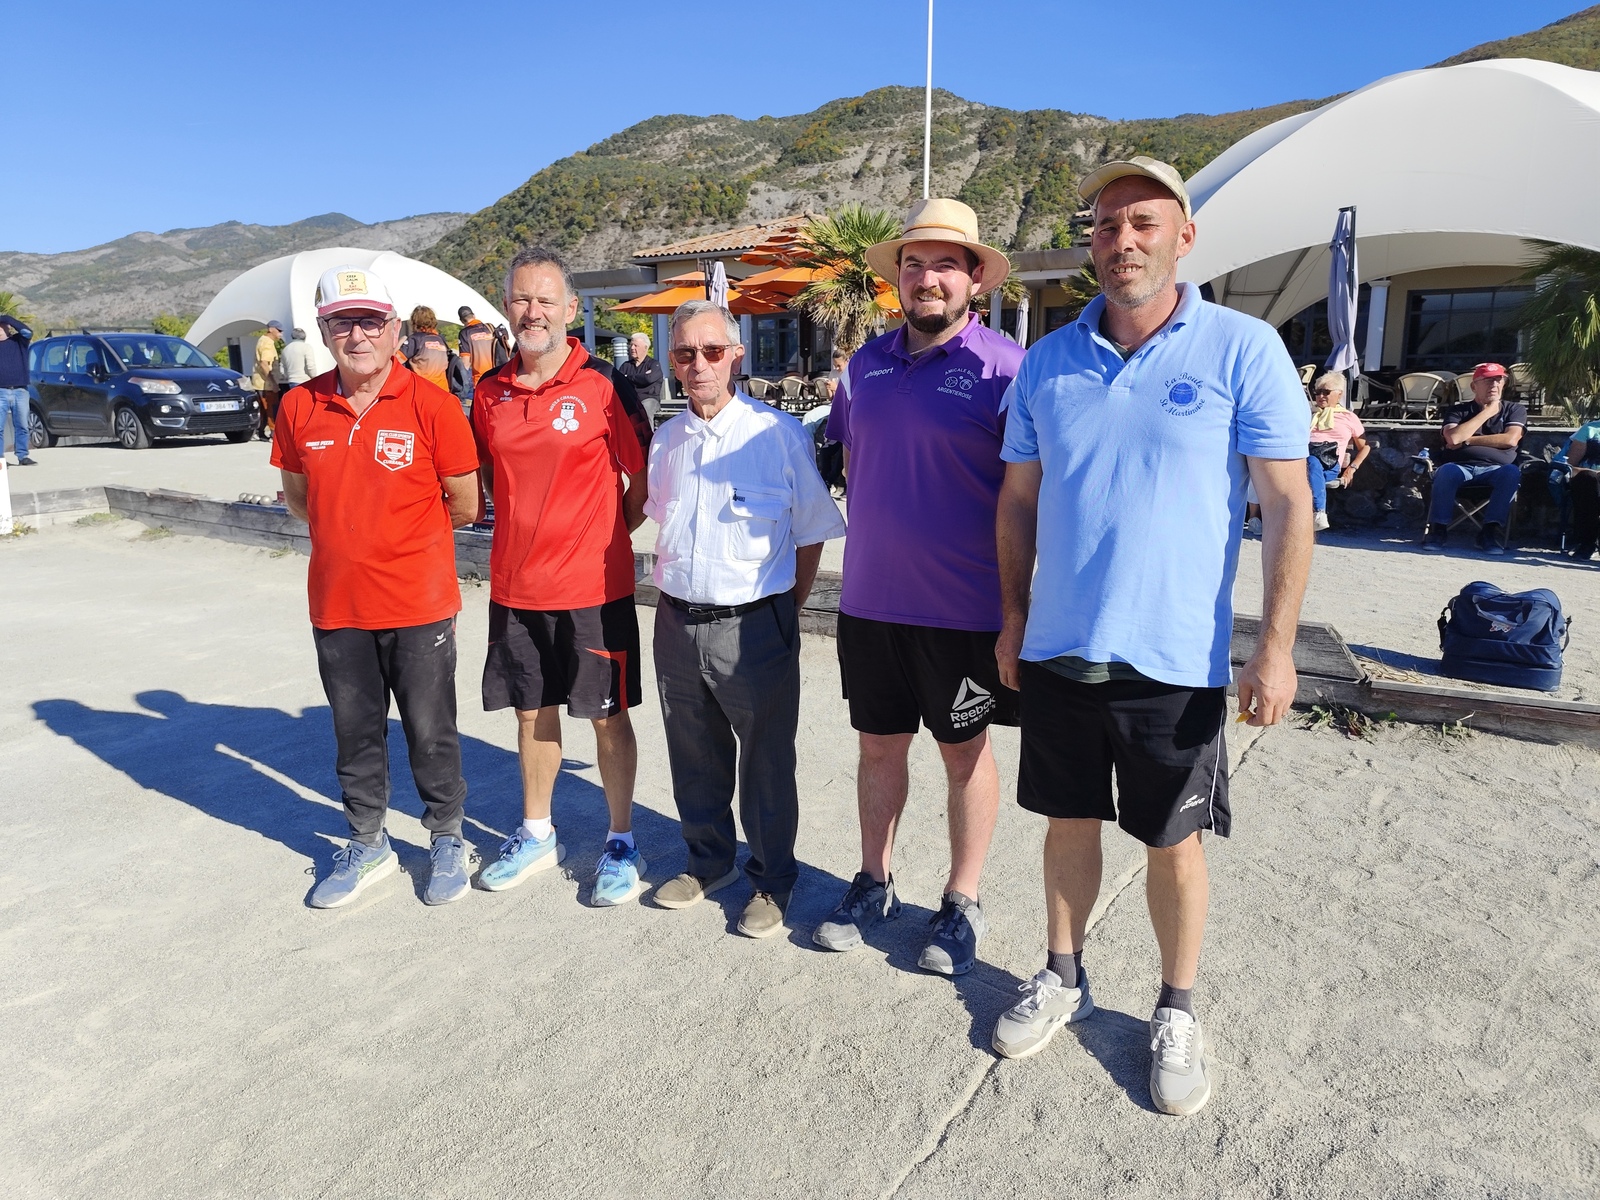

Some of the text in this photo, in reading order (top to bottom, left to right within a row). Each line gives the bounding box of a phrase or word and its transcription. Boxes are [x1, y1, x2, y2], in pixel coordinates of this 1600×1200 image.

[864, 367, 894, 379] uhlsport
[944, 367, 980, 384] AMICALE BOULE
[1164, 372, 1204, 389] La Boule
[936, 386, 973, 401] ARGENTIEROISE
[950, 695, 996, 722] Reebok
